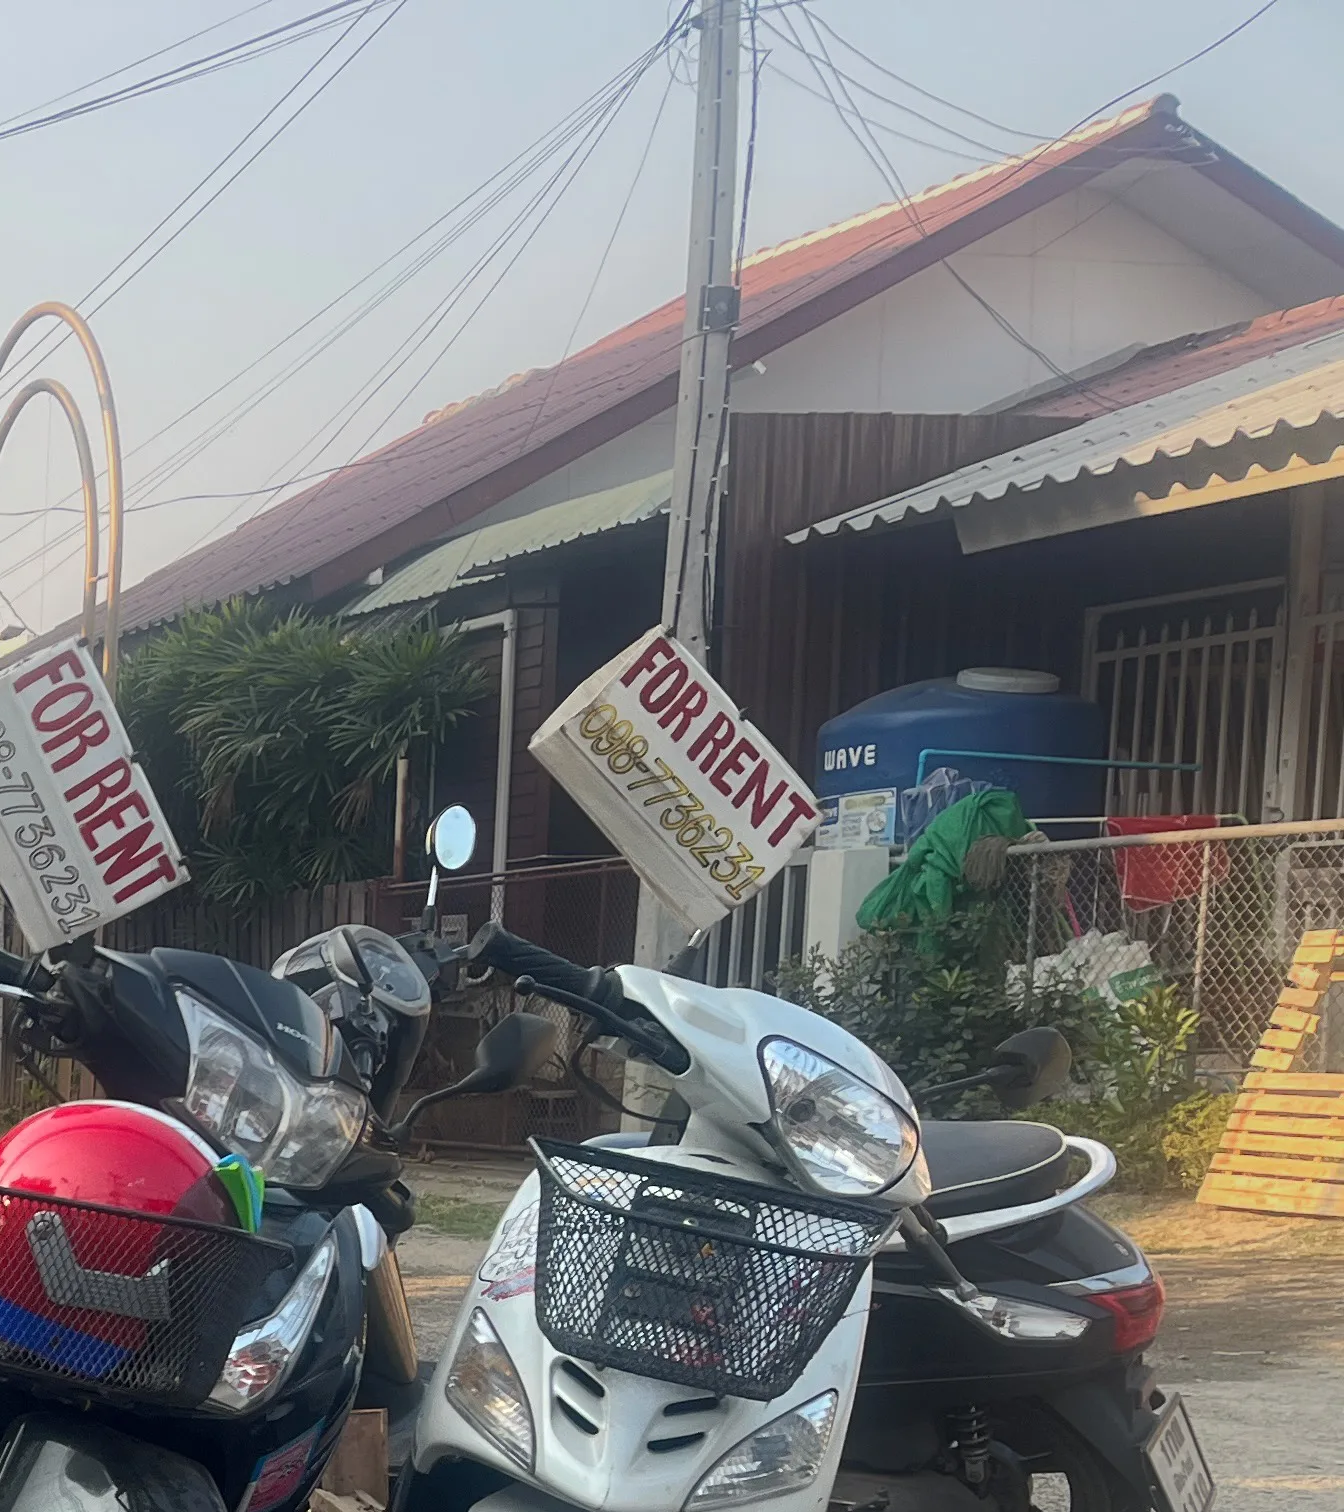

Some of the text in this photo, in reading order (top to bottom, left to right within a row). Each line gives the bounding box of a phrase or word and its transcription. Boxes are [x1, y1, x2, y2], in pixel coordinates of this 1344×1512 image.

[13, 649, 177, 905] FOR RENT
[579, 704, 766, 901] 098-7736231
[620, 637, 817, 848] FOR RENT
[824, 744, 876, 771] WAVE
